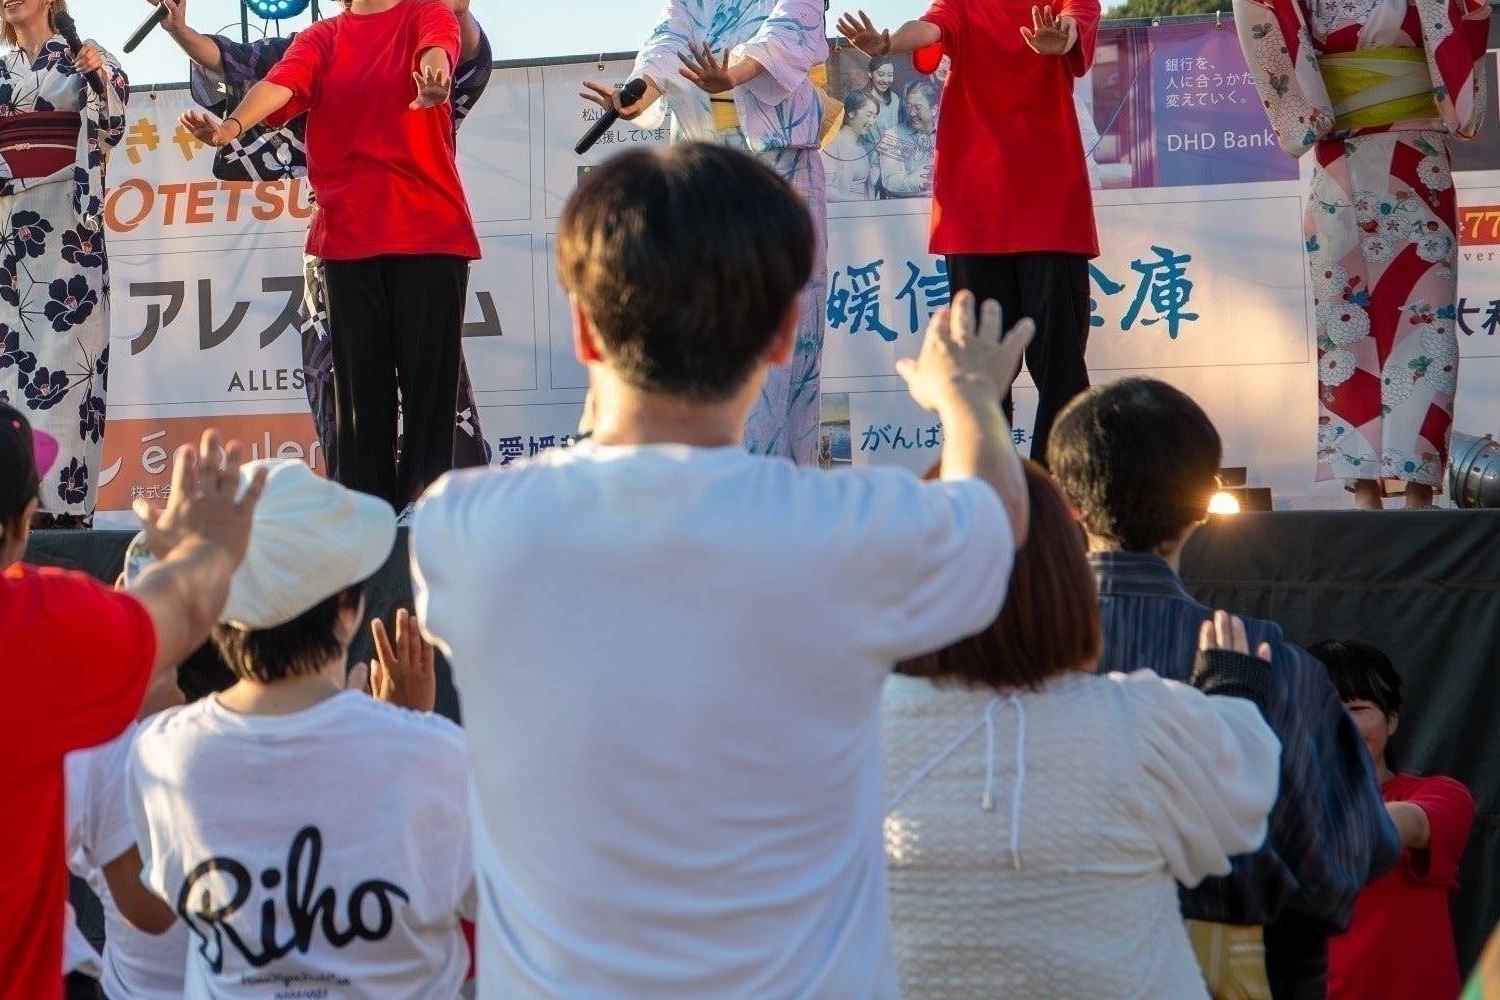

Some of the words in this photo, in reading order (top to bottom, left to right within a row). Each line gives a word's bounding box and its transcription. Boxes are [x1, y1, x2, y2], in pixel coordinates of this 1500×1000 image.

[1165, 56, 1216, 72] 銀行を、
[1166, 90, 1247, 108] 変えていく。
[594, 128, 671, 145] 援していま
[1167, 132, 1216, 152] DHD
[1224, 128, 1275, 149] Bank
[104, 178, 315, 234] OTETSU
[498, 435, 575, 467] 愛媛
[178, 825, 410, 974] Riho
